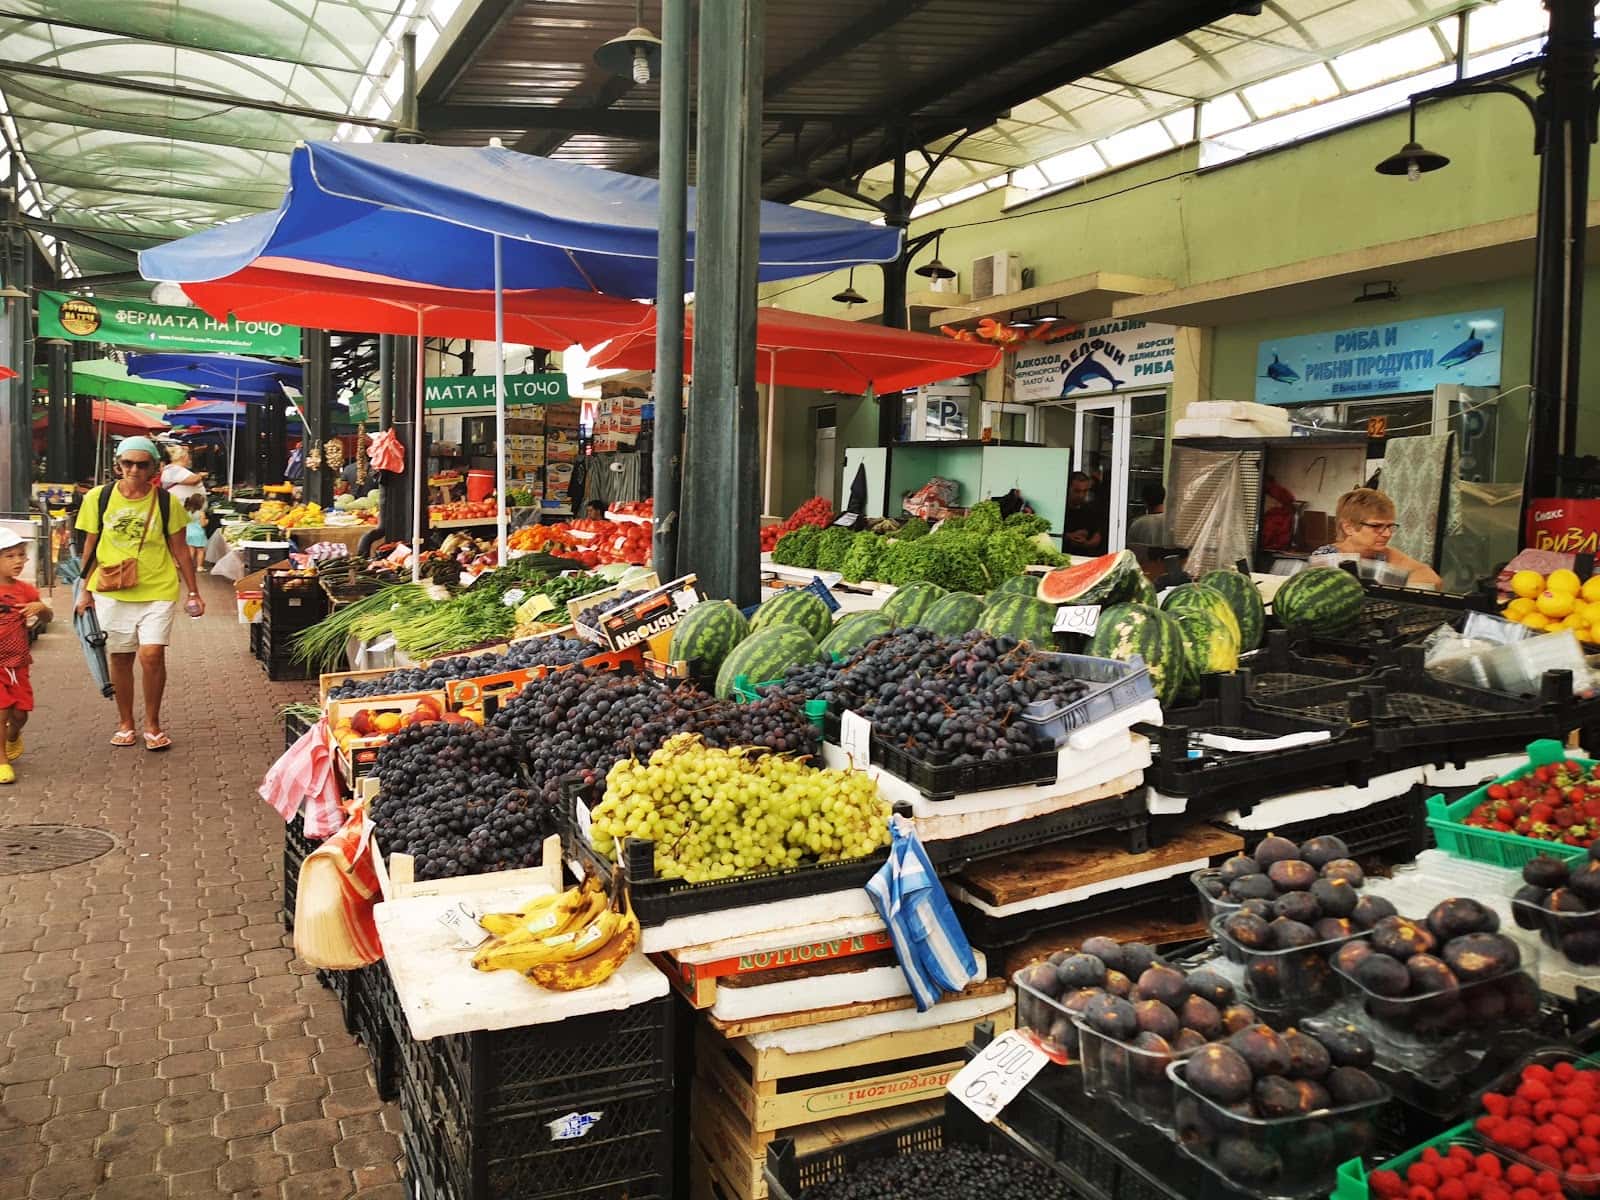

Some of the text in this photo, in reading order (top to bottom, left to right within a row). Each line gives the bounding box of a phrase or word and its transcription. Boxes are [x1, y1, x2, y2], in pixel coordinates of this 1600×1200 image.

[115, 309, 199, 329] ФЕРМАТА
[235, 320, 282, 337] ГОЧО
[1335, 327, 1398, 353] РИБА И
[1015, 354, 1061, 370] АЛКОХОЛ
[1133, 359, 1175, 377] РИБА
[1305, 348, 1435, 382] РИБНИ ПРОДУКТИ
[426, 384, 478, 401] МАТА
[514, 380, 560, 398] ГОЧО
[985, 1036, 1034, 1075] 500
[847, 1072, 951, 1105] Bergonzoni
